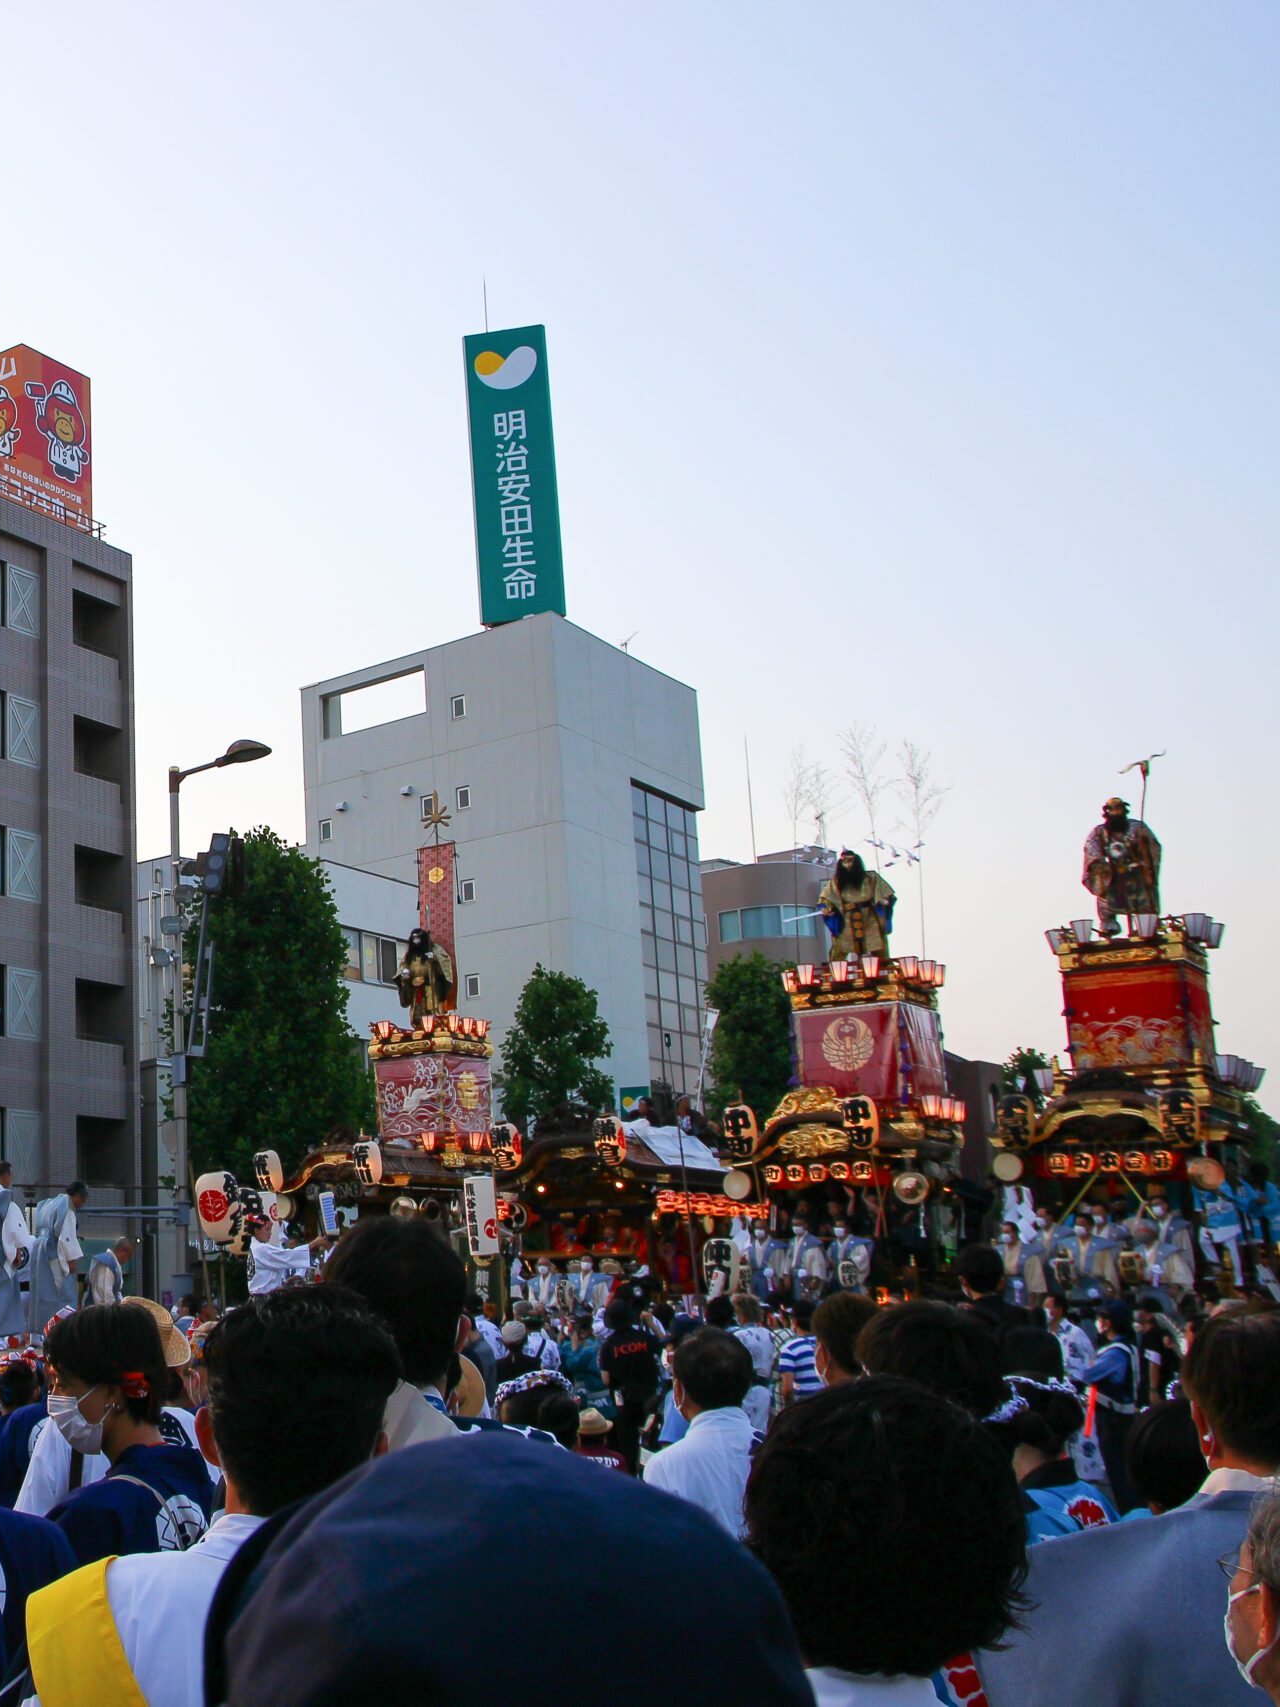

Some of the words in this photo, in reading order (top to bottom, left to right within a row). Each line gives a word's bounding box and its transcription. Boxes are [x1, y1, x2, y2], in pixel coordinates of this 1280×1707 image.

[493, 409, 537, 600] 明治安田生命
